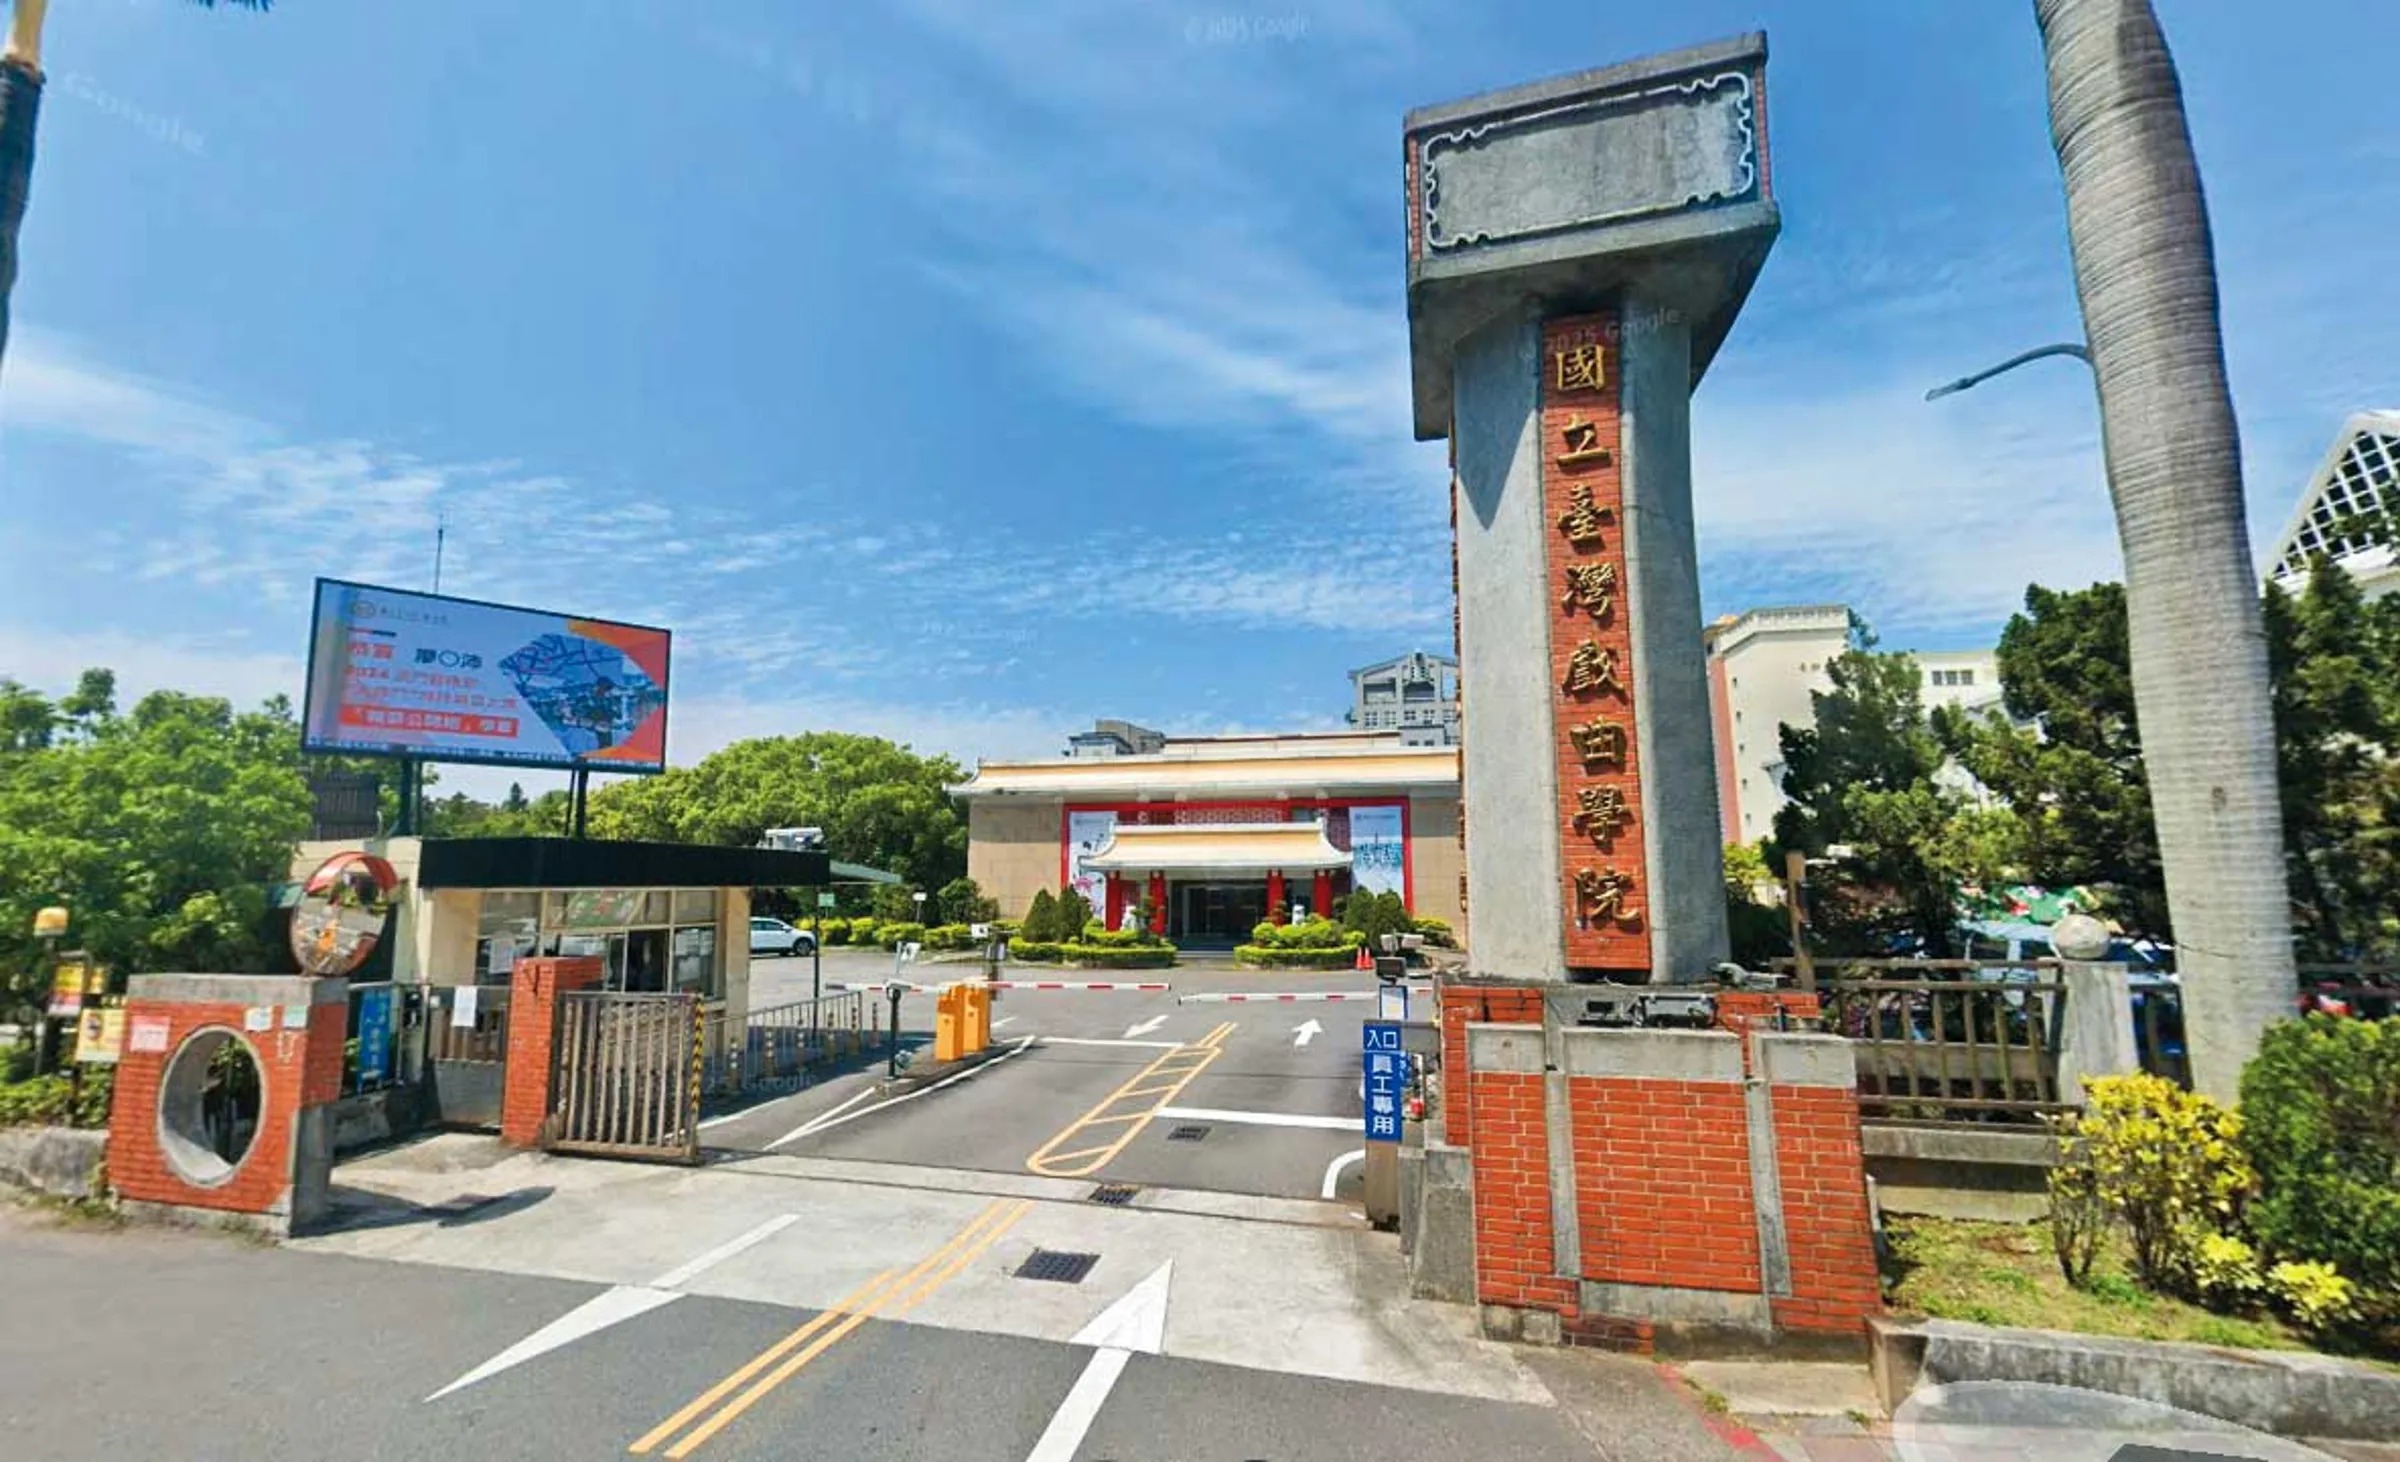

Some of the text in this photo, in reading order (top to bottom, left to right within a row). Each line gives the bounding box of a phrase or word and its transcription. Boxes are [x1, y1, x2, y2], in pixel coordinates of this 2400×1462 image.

[1366, 1029, 1398, 1050] 入口
[1371, 1053, 1395, 1135] 員工專用
